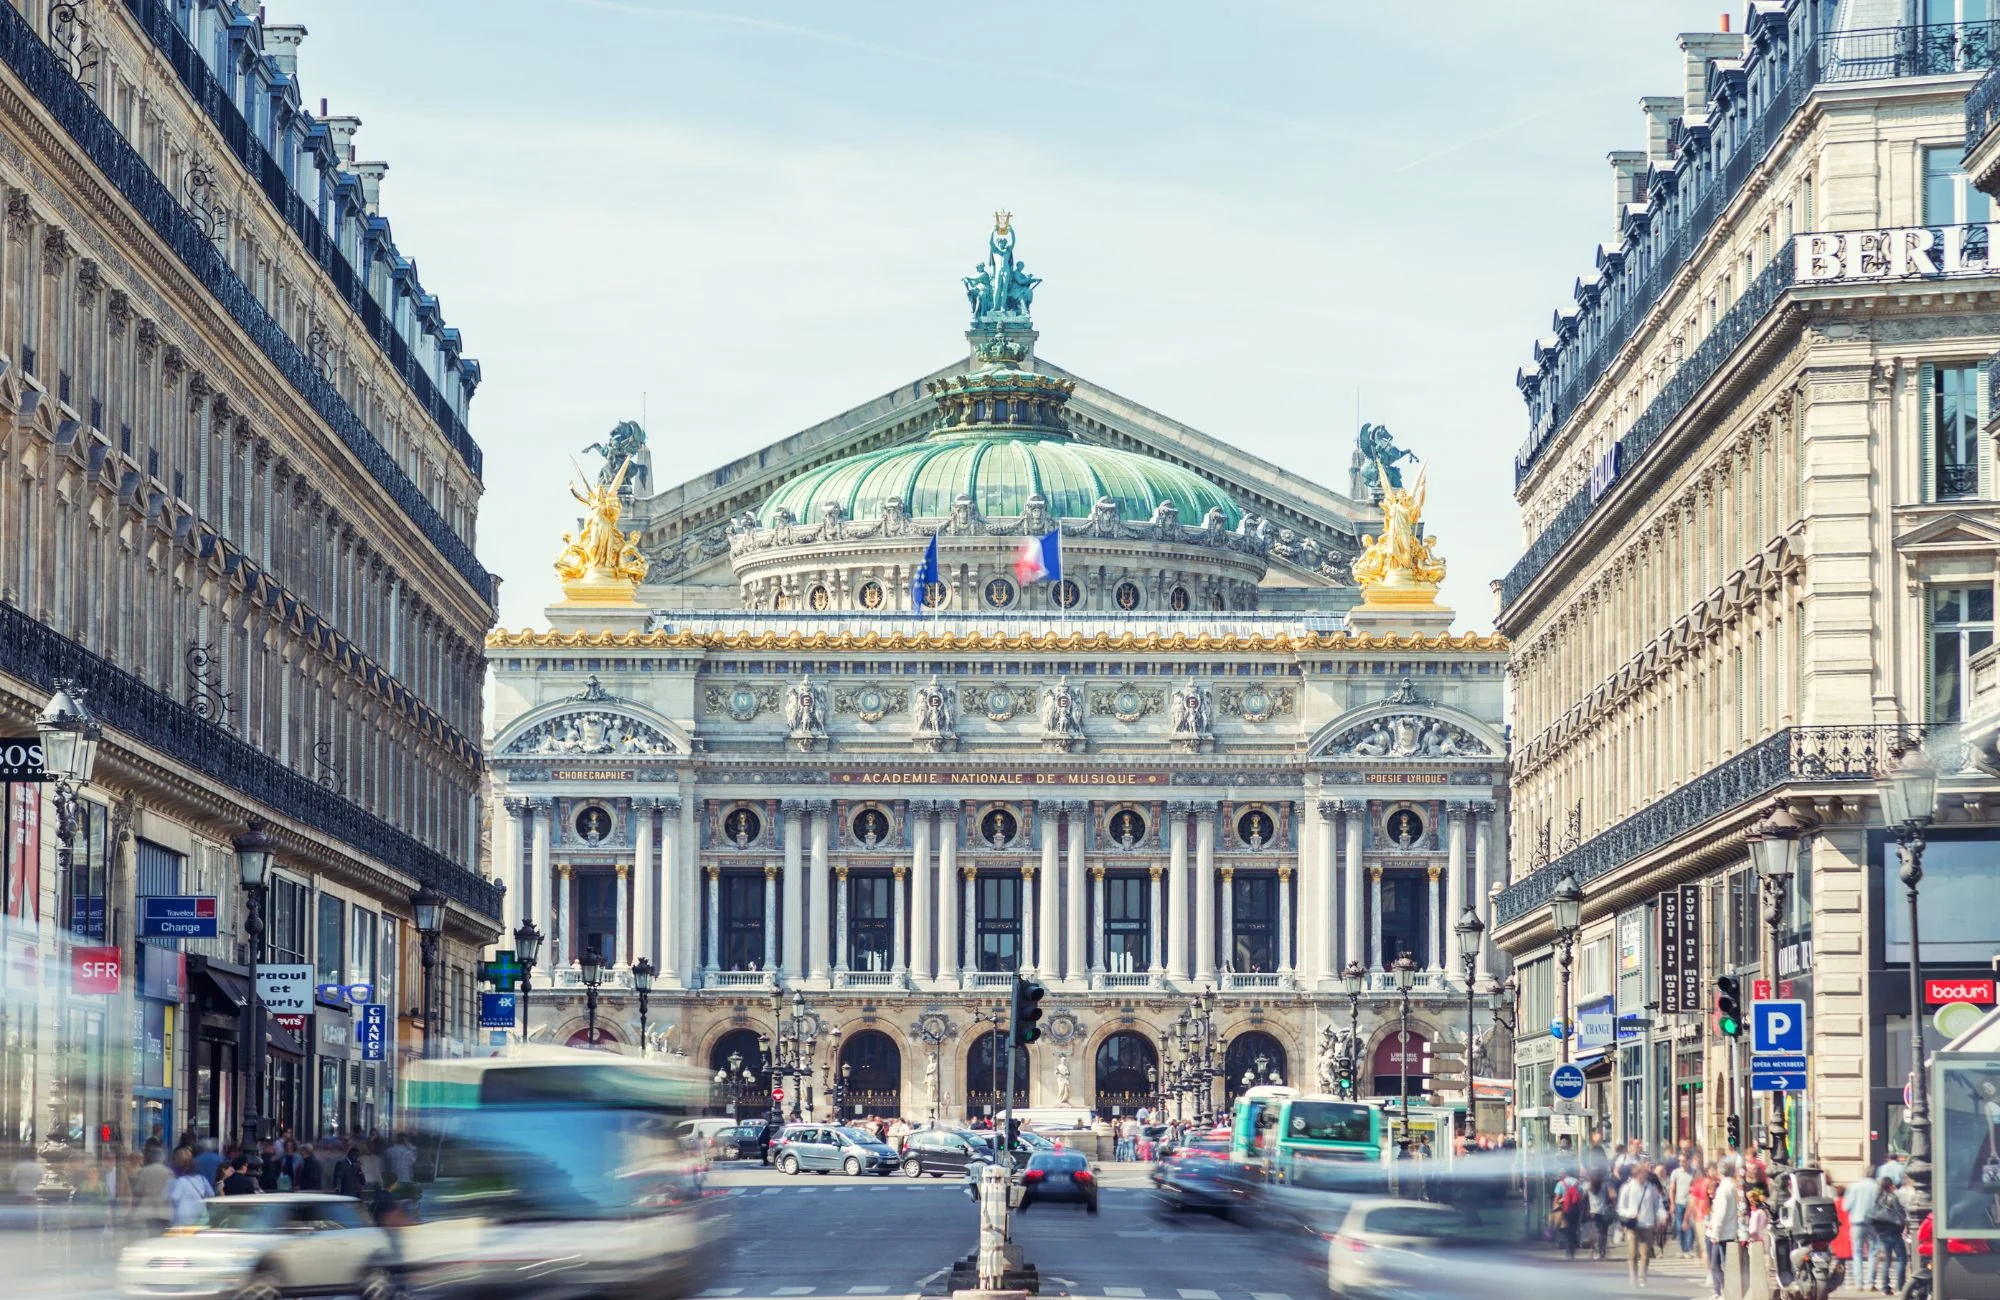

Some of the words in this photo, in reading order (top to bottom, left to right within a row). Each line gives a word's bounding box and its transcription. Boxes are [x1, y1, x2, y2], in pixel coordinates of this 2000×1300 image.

[559, 771, 626, 780] CHOREGRAPHIE
[862, 773, 937, 784] ACADEMIE
[951, 773, 1022, 784] NATIONALE
[1036, 774, 1055, 784] DE
[1068, 774, 1136, 784] MUSIQUE
[1370, 774, 1401, 783] POESIE
[1407, 774, 1441, 783] LYRIQUE
[167, 909, 194, 917] Travelex
[1666, 897, 1675, 937] royal
[1685, 889, 1695, 931] royal
[161, 922, 200, 934] Change
[1666, 945, 1675, 967] air
[1686, 938, 1695, 962] air
[82, 962, 118, 978] SFR
[256, 972, 306, 980] raoul
[270, 985, 291, 993] et
[1664, 974, 1677, 1011] maroc
[1684, 969, 1697, 1006] maroc
[1932, 983, 1988, 998] bodum
[267, 998, 304, 1008] urly
[368, 1007, 380, 1058] CHANGE
[1585, 1023, 1610, 1035] CHANGE
[1767, 1012, 1791, 1044] P
